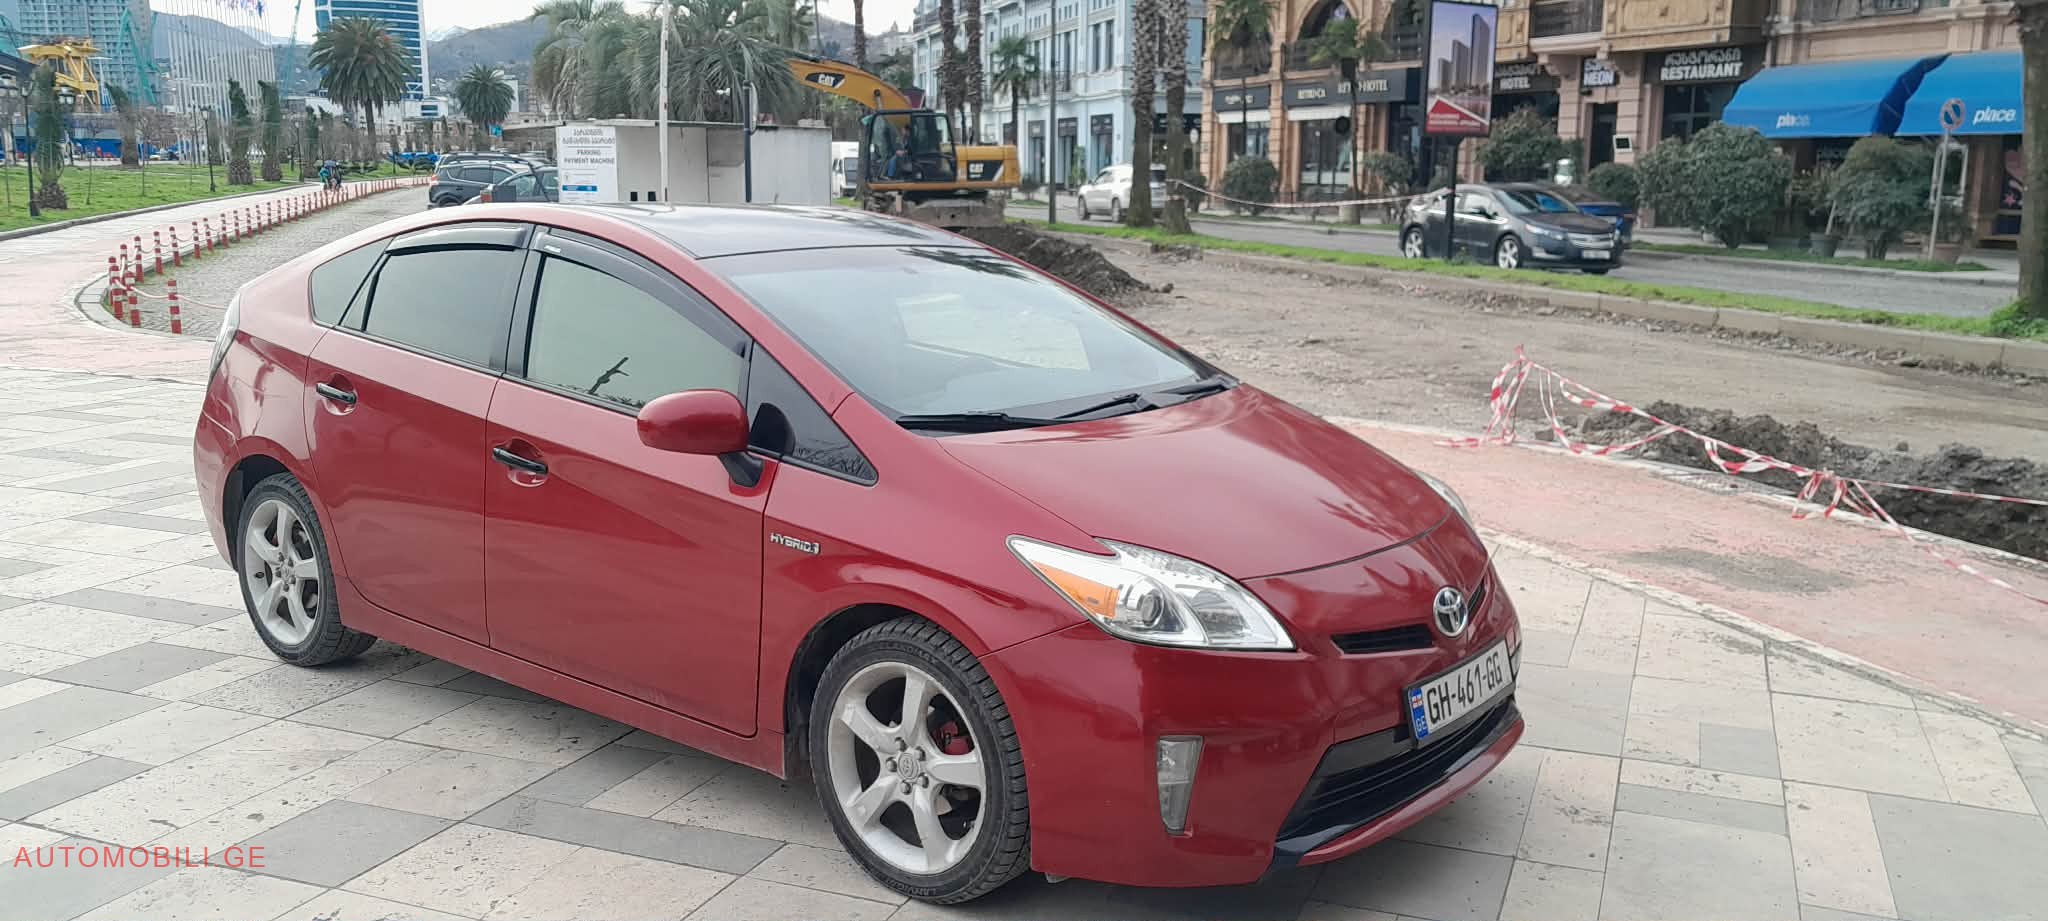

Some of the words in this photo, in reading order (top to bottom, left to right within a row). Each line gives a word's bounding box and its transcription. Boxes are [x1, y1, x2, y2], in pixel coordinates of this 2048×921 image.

[818, 73, 835, 87] CAT
[1583, 71, 1616, 87] NEON
[1660, 62, 1743, 81] RESTAURANT
[1500, 77, 1530, 90] HOTEL
[1972, 106, 2017, 126] place
[1426, 651, 1503, 724] GH-461-GG
